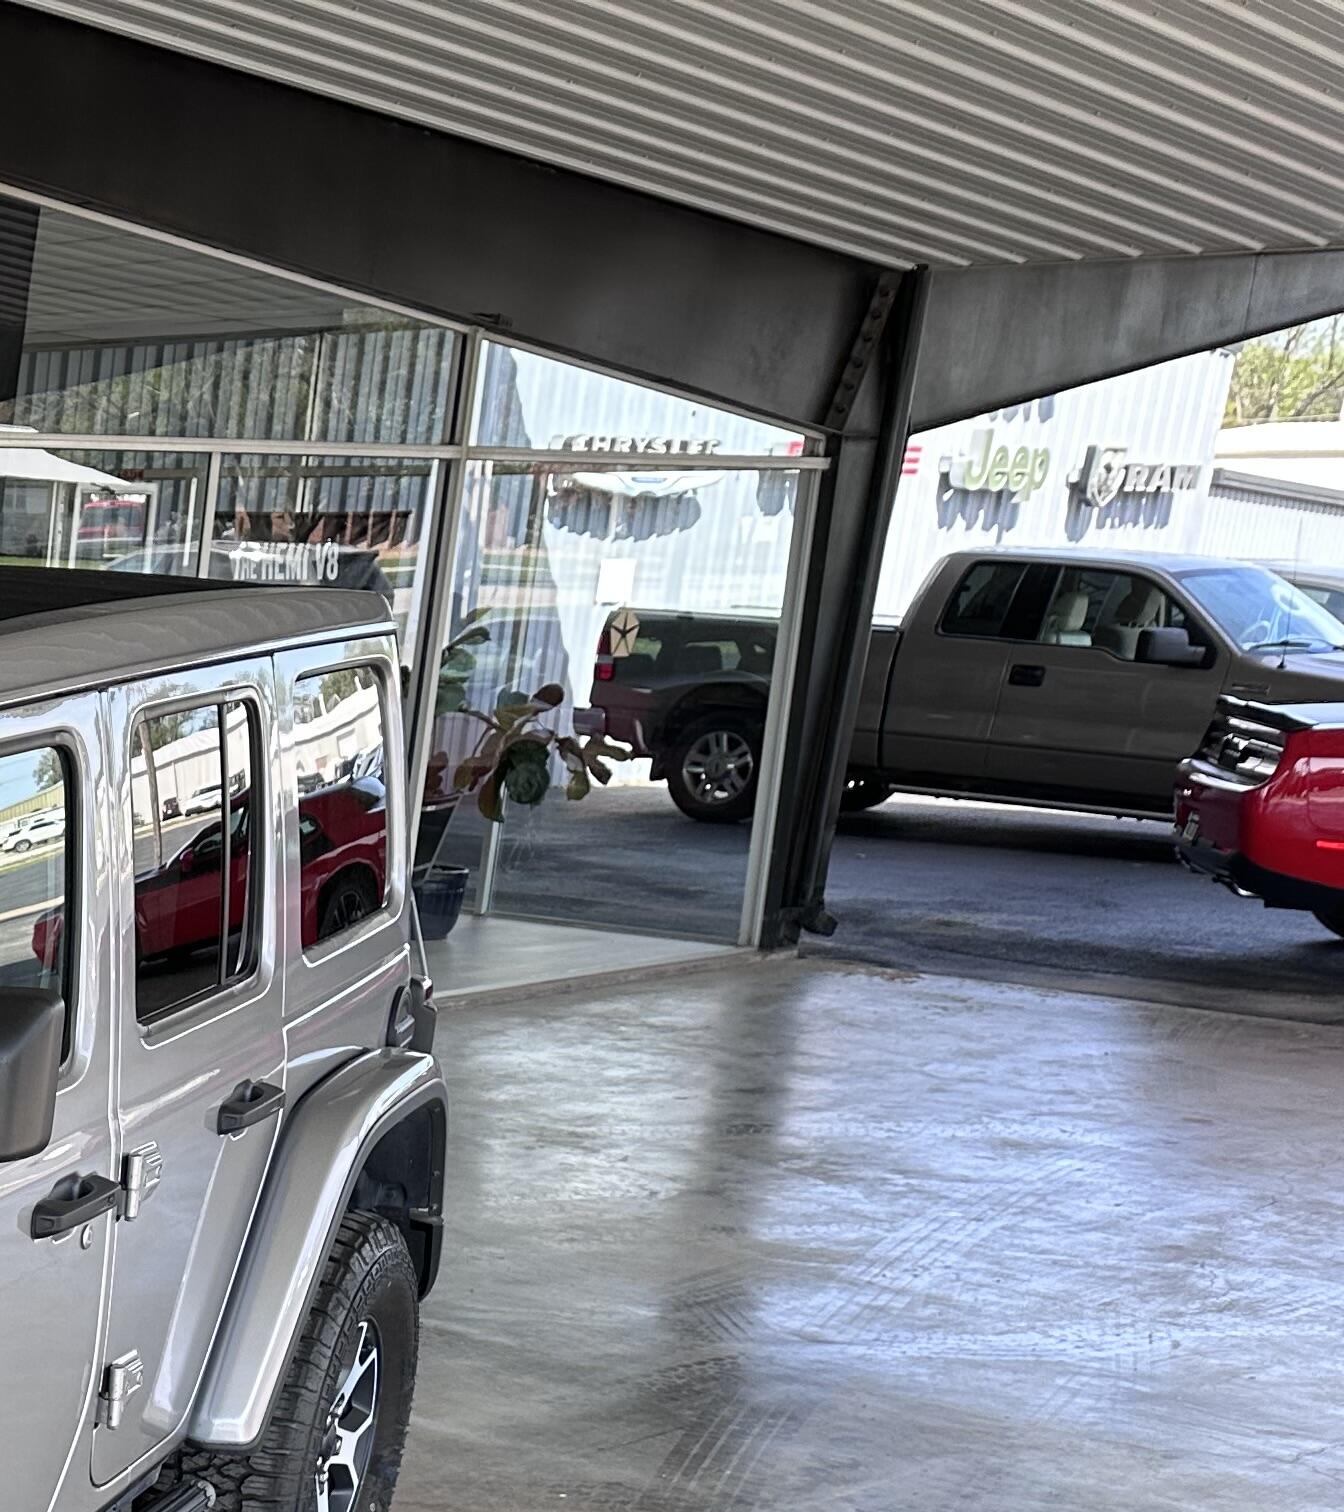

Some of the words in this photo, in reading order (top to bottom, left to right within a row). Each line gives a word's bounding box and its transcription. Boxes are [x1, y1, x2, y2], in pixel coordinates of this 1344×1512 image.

[962, 428, 1050, 504] Jeep
[1123, 463, 1202, 492] RAM
[261, 542, 311, 580] HEMI
[315, 541, 340, 580] V8
